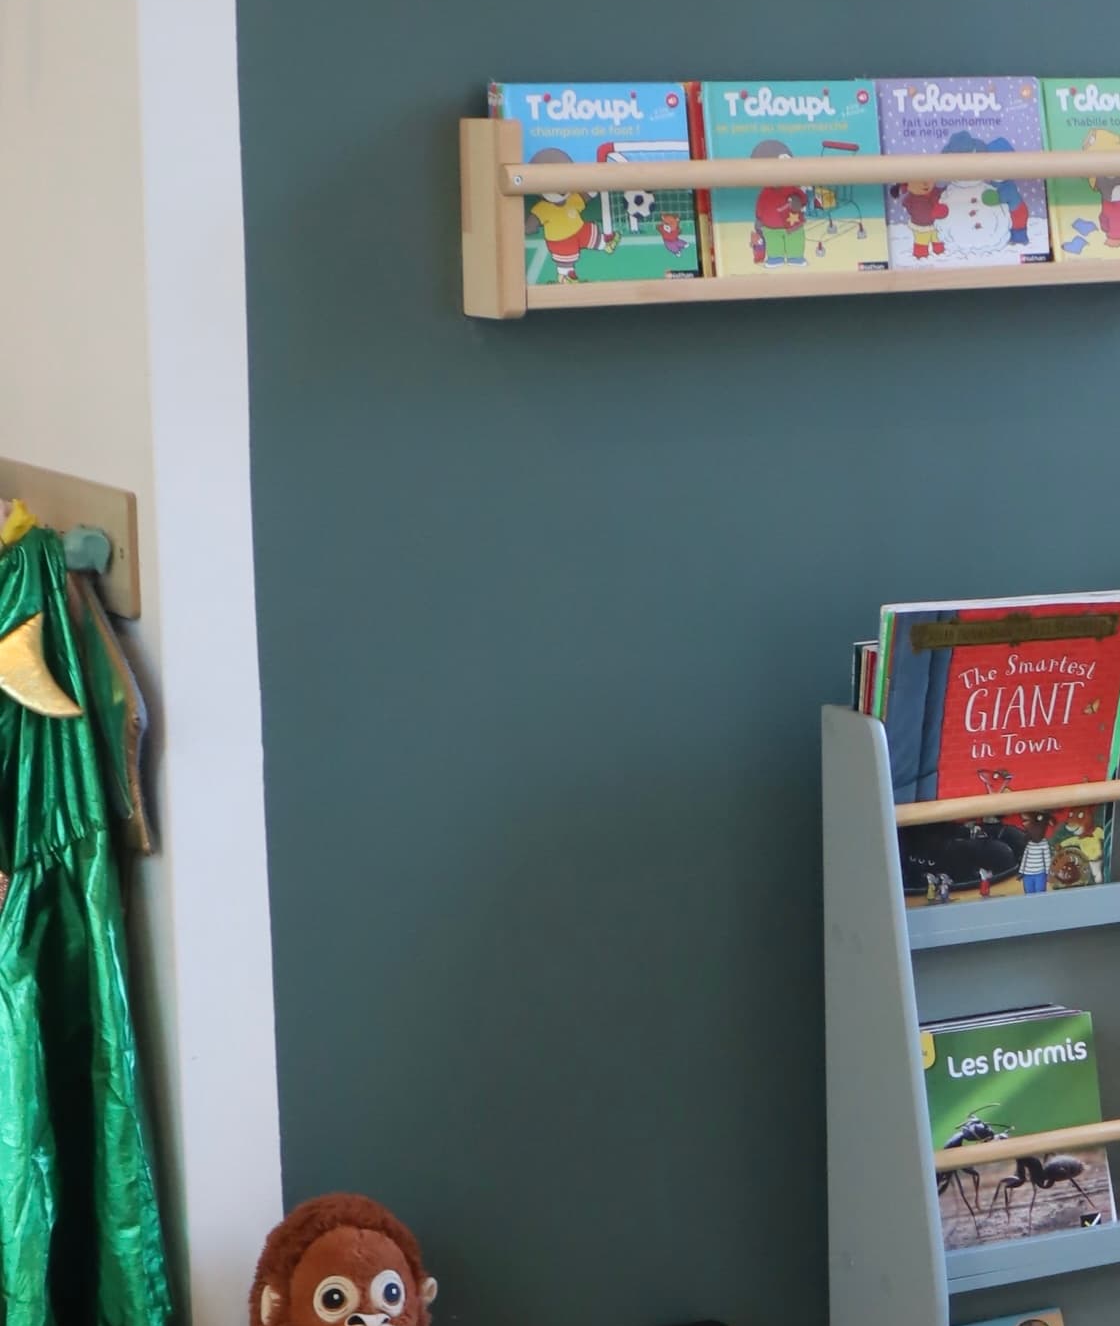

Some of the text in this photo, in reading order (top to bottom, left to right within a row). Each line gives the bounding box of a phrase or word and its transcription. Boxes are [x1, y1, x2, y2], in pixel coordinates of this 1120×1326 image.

[525, 88, 645, 126] T'choupi
[723, 85, 837, 122] T'choupi
[892, 83, 1002, 118] T'choupi
[529, 124, 589, 139] champion
[591, 124, 605, 137] de
[902, 116, 1002, 128] fait un bonhomme
[903, 128, 950, 139] de neige
[958, 653, 1096, 690] The Smartest
[963, 680, 1085, 734] GIANT
[970, 732, 1062, 760] in Town
[947, 1037, 1088, 1078] Les fourmis
